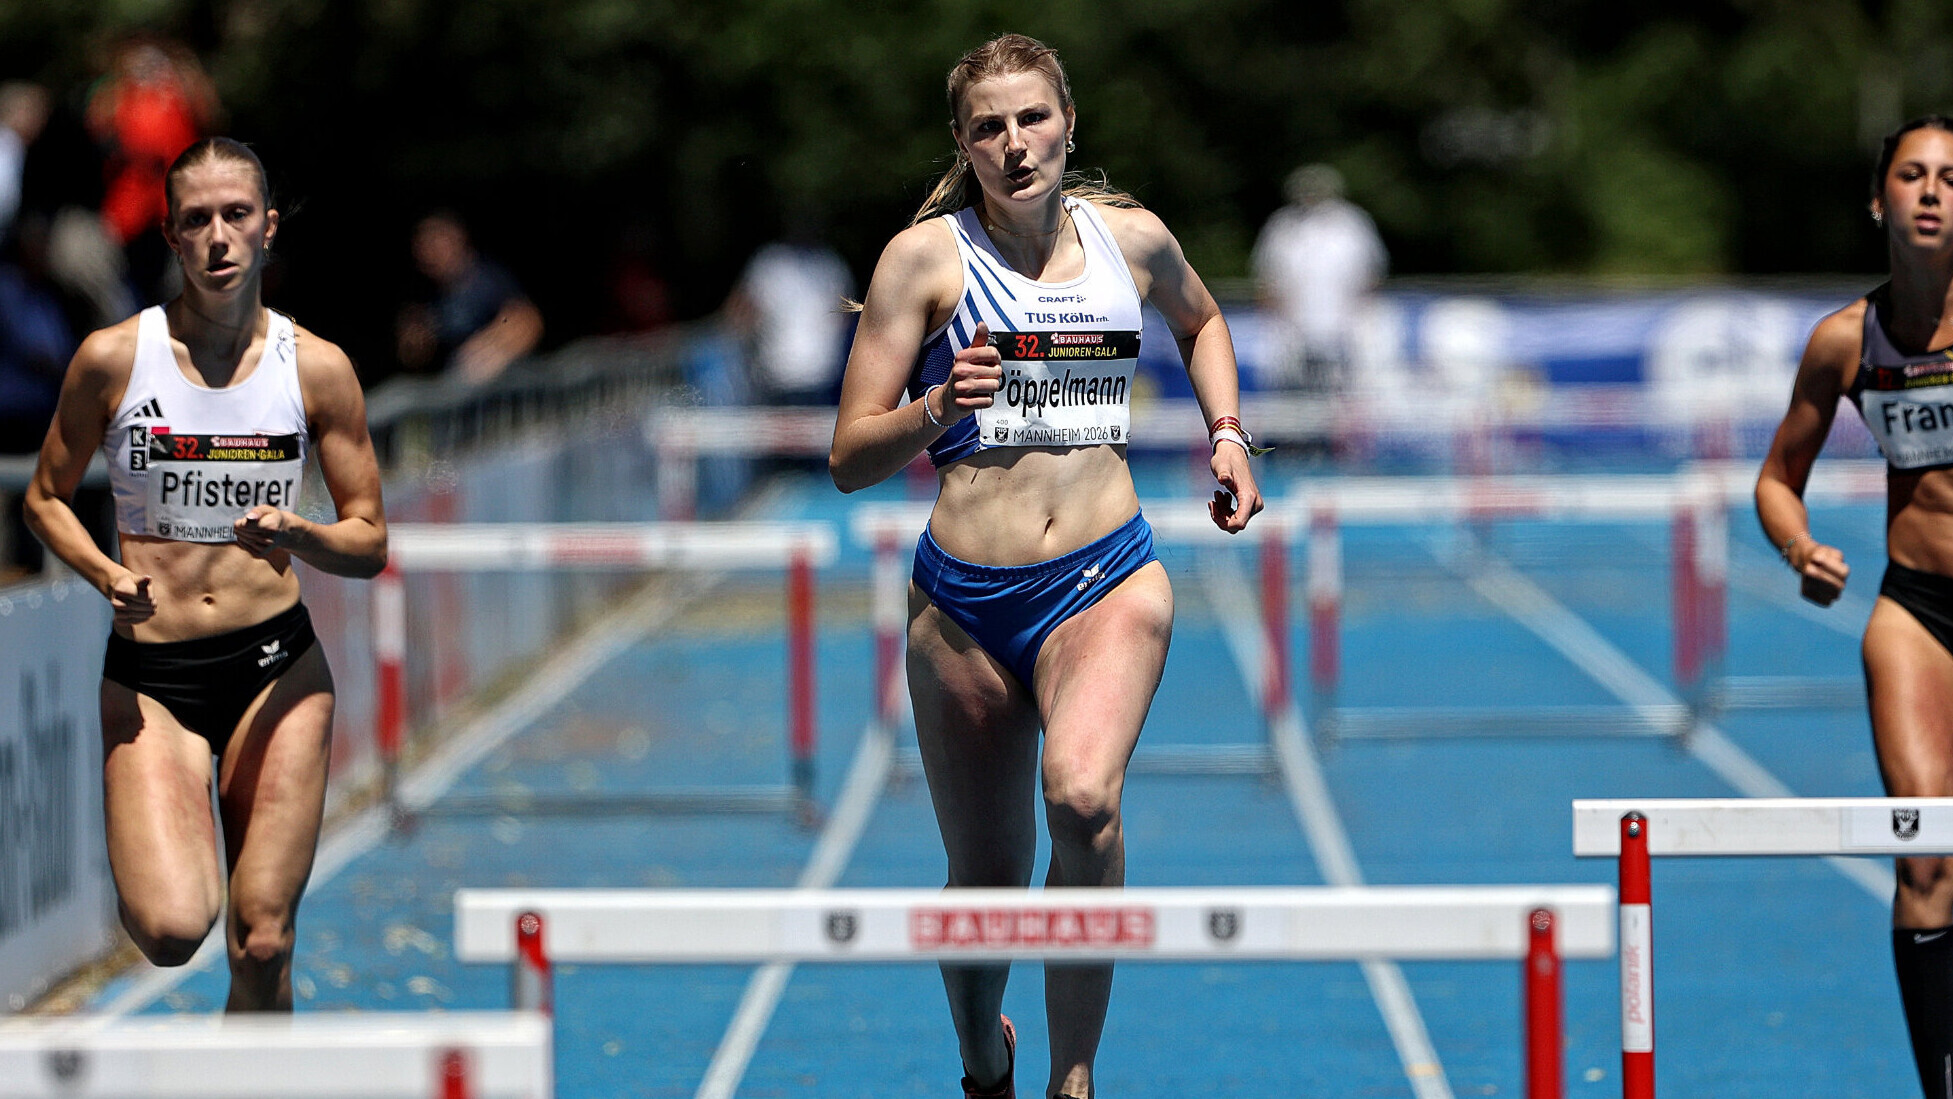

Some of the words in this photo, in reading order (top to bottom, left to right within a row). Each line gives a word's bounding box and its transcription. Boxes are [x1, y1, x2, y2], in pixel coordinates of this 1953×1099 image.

[1025, 312, 1057, 324] TUS
[1059, 312, 1095, 324] Köln
[1014, 334, 1045, 358] 32.
[1059, 335, 1104, 345] BAUHAUS
[1048, 346, 1118, 358] JUNIOREN-GALA
[132, 428, 145, 446] K
[1013, 428, 1081, 443] MANNHEIM
[1084, 426, 1109, 441] 2026
[172, 436, 205, 459] 32.
[219, 437, 270, 448] BAUHAUS
[206, 448, 286, 460] JUNIOREN-GALA
[132, 452, 143, 469] 3
[161, 471, 294, 507] Pfisterer
[175, 525, 235, 539] MANNHEI
[909, 905, 1156, 948] BAUHAUS
